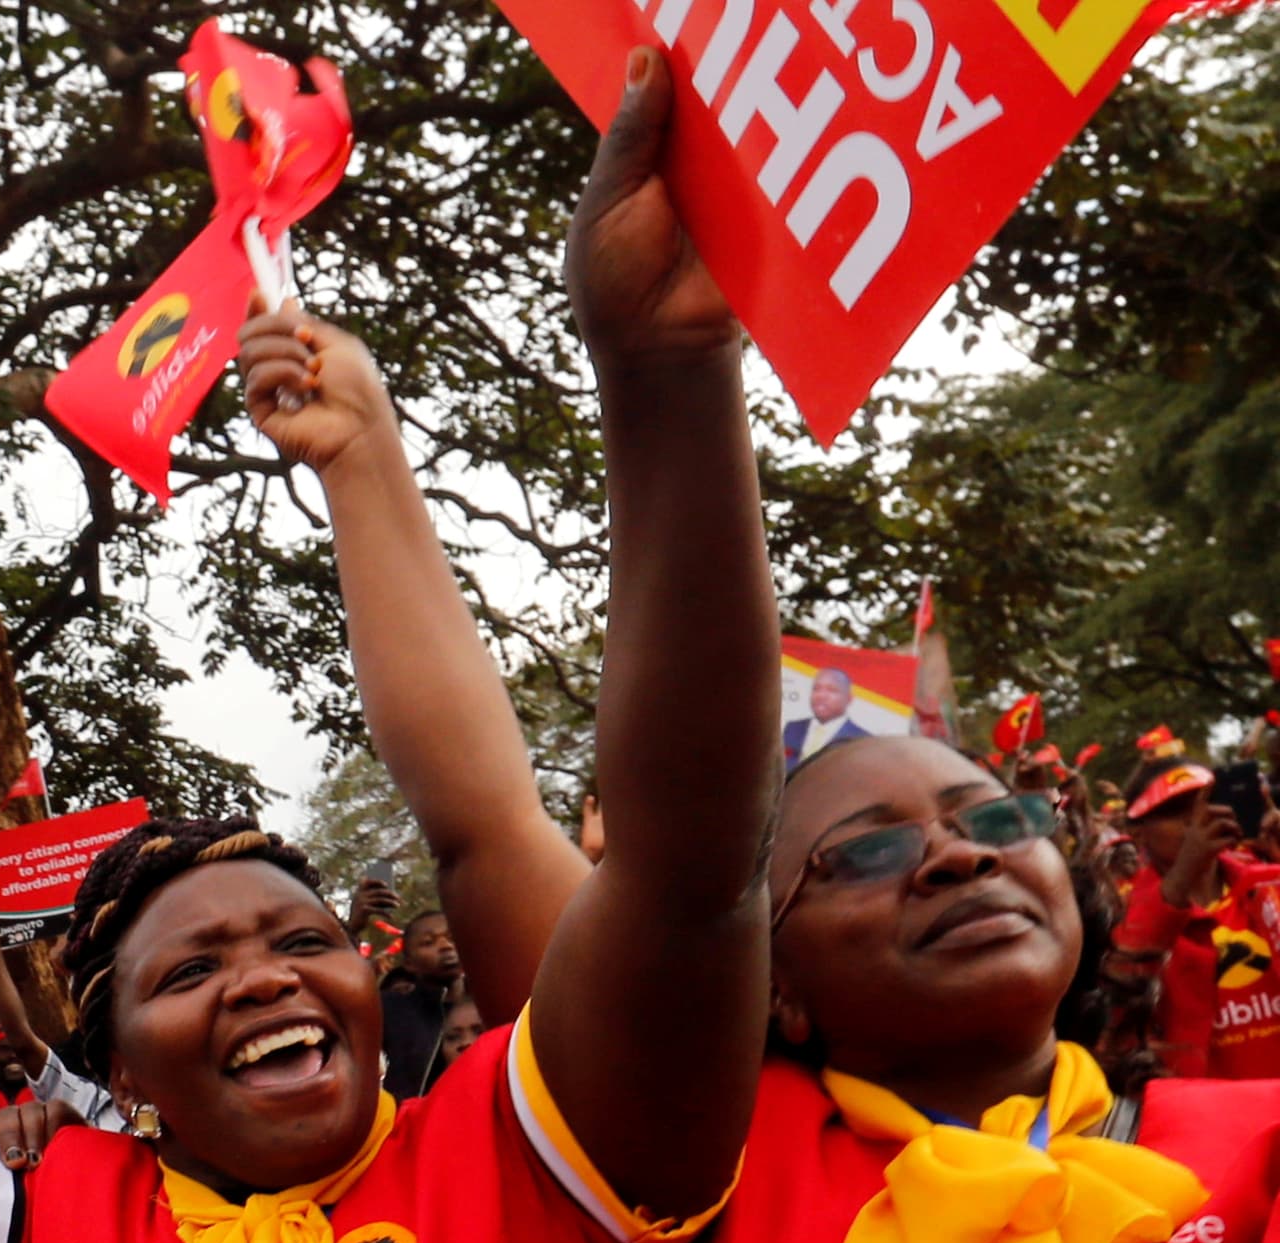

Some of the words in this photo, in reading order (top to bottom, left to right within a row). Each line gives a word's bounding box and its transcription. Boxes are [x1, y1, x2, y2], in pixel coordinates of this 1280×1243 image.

[633, 0, 911, 312] UHU
[25, 841, 71, 860] citizen
[18, 865, 33, 878] to
[37, 854, 87, 874] reliable
[1, 872, 72, 897] affordable
